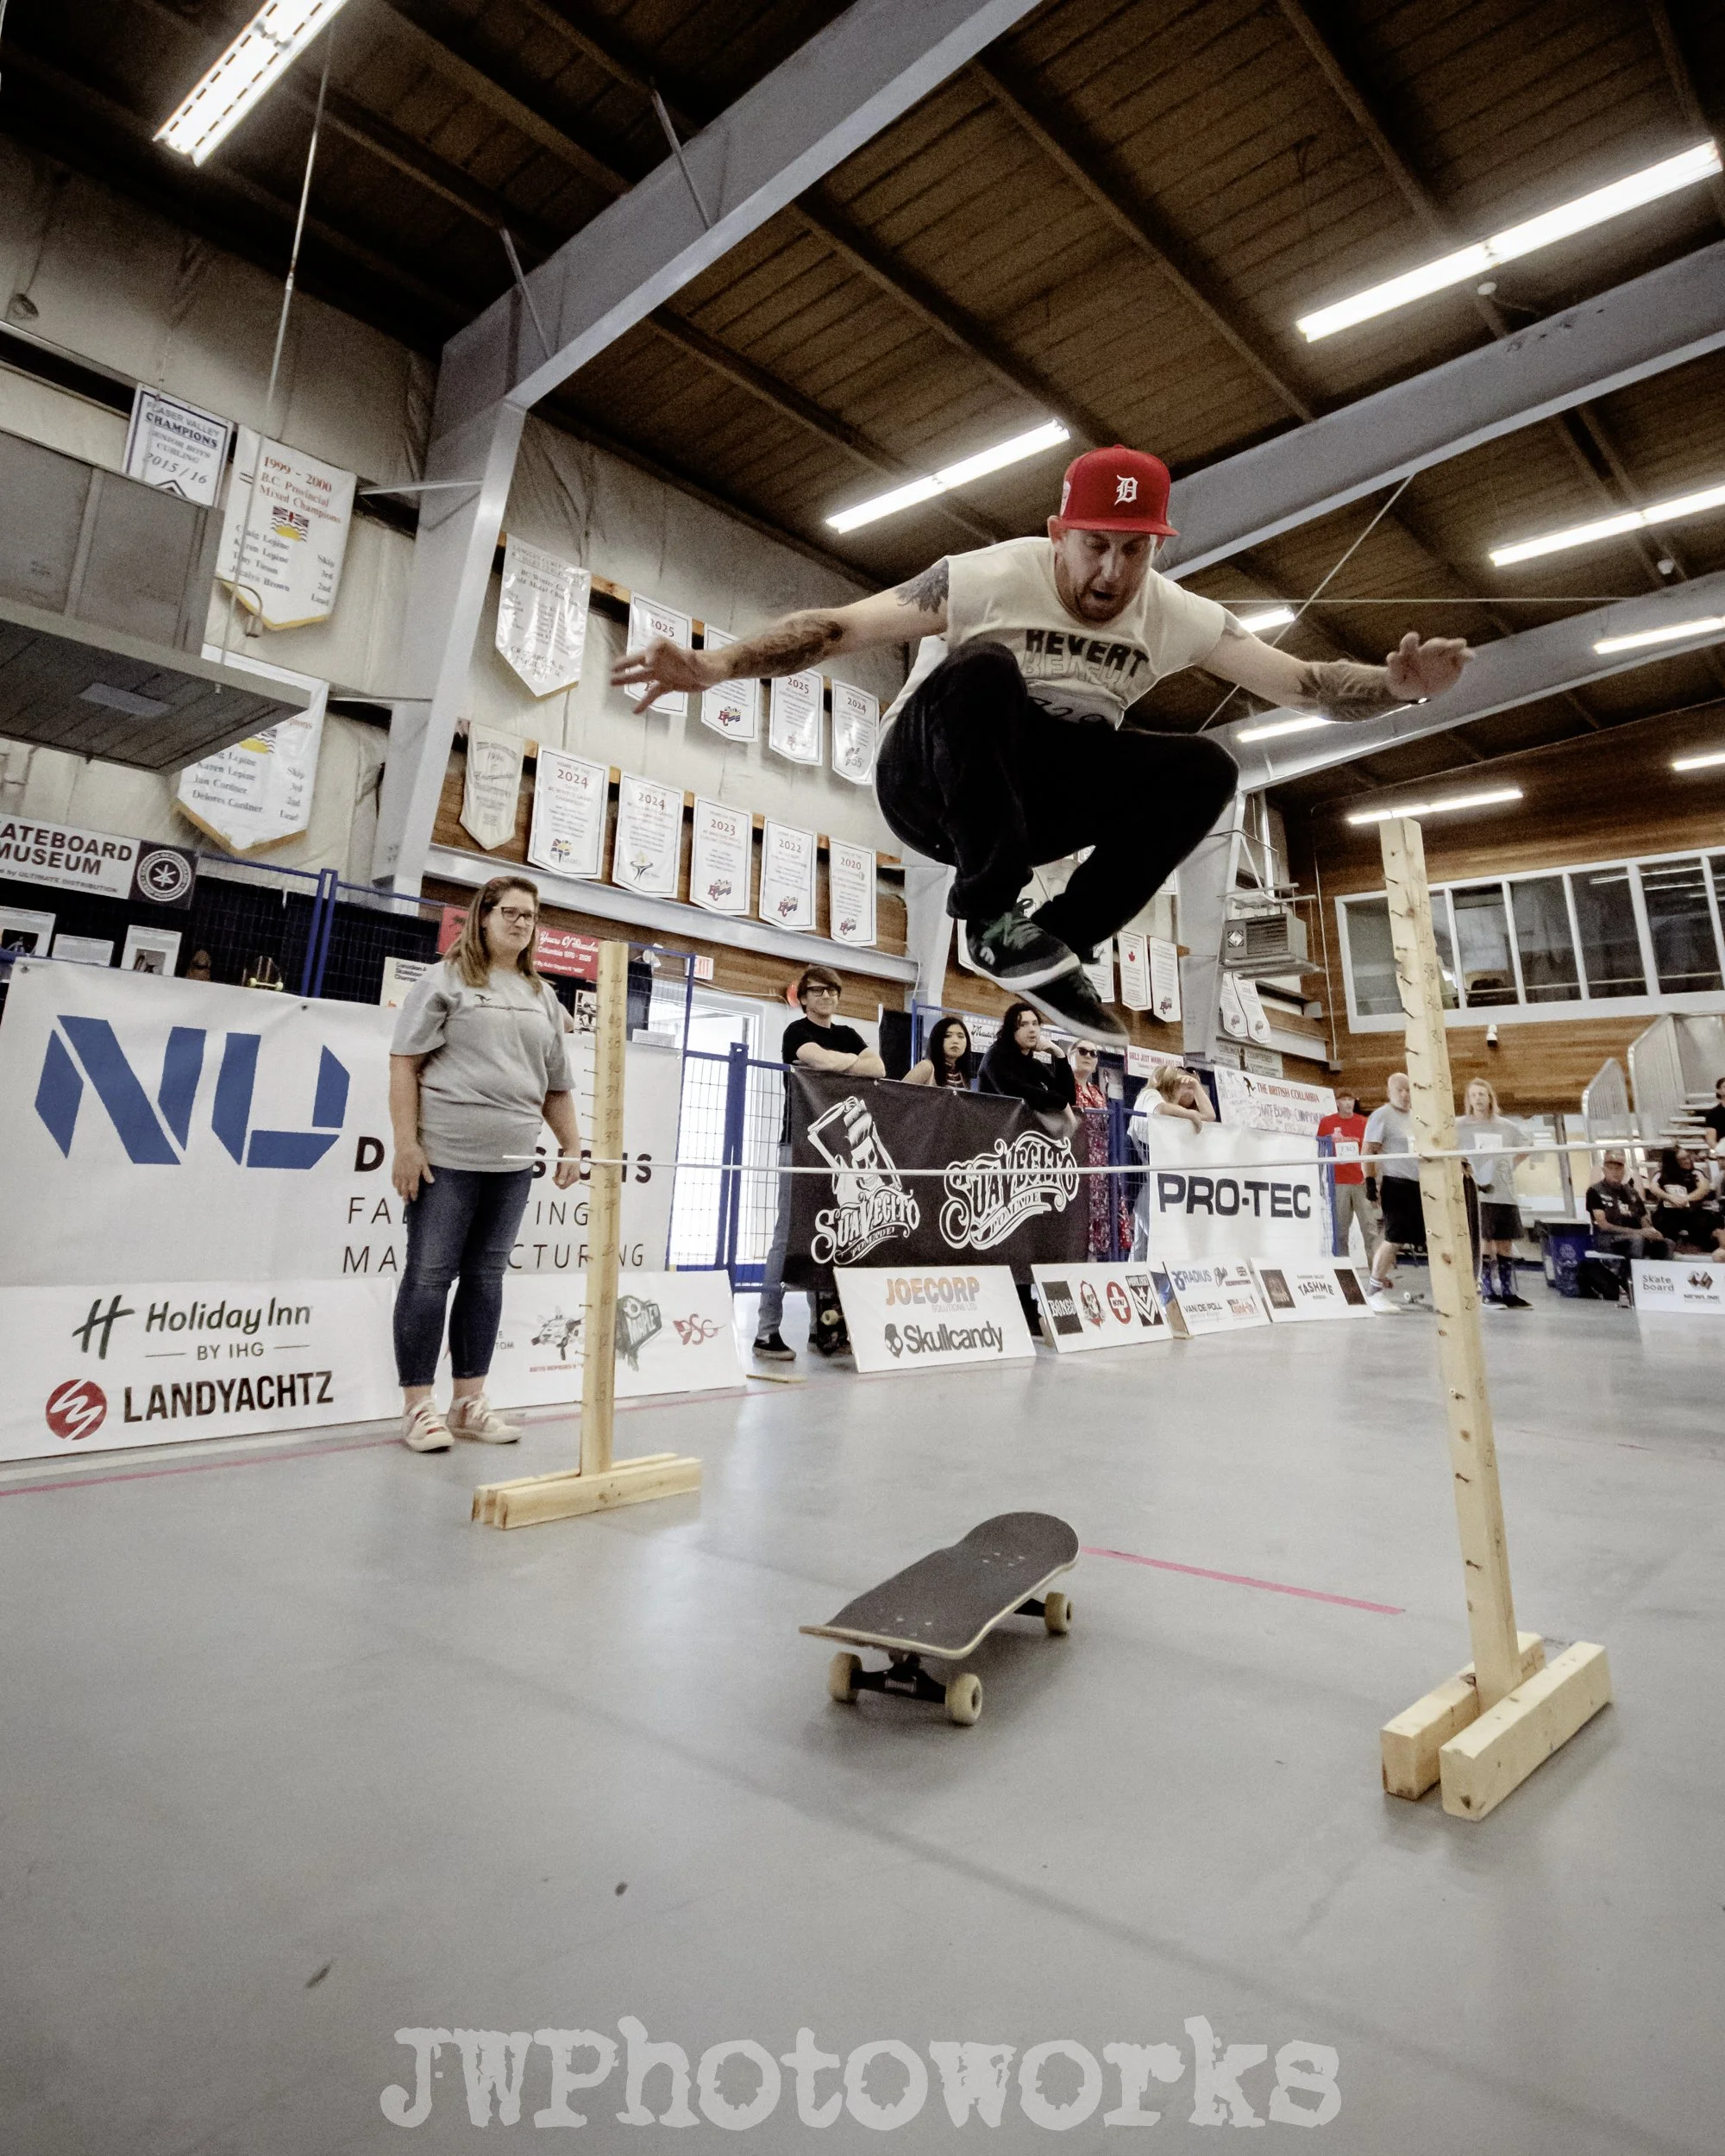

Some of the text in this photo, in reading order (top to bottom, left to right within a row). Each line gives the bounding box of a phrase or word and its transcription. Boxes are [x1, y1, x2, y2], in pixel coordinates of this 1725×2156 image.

[146, 412, 217, 448] CHAMPIONS
[143, 453, 179, 473] 2015
[191, 472, 208, 484] 16
[264, 456, 292, 474] 1999
[306, 474, 332, 493] 2000
[285, 481, 329, 507] Provincial
[1114, 474, 1138, 505] D
[260, 485, 342, 523] Mixed Champions
[787, 676, 809, 693] 2025
[848, 698, 866, 714] 2024
[557, 769, 588, 789] 2024
[638, 793, 665, 810] 2024
[711, 819, 736, 836] 2023
[779, 839, 801, 853] 2022
[840, 857, 862, 870] 2020
[694, 957, 710, 975] XIT
[811, 1191, 920, 1264] SUAVECITO
[1182, 1269, 1212, 1283] RADIUS
[1642, 1275, 1672, 1284] Skate
[886, 1276, 980, 1306] JOECORP
[1297, 1281, 1335, 1296] TASHME
[1643, 1282, 1674, 1292] board
[1208, 1302, 1223, 1311] POLL
[145, 1300, 263, 1336] Holiday
[267, 1297, 311, 1327] Inn
[904, 1320, 1002, 1353] Skullcandy
[197, 1343, 265, 1361] BY IHG
[123, 1370, 334, 1424] LANDYACHTZ
